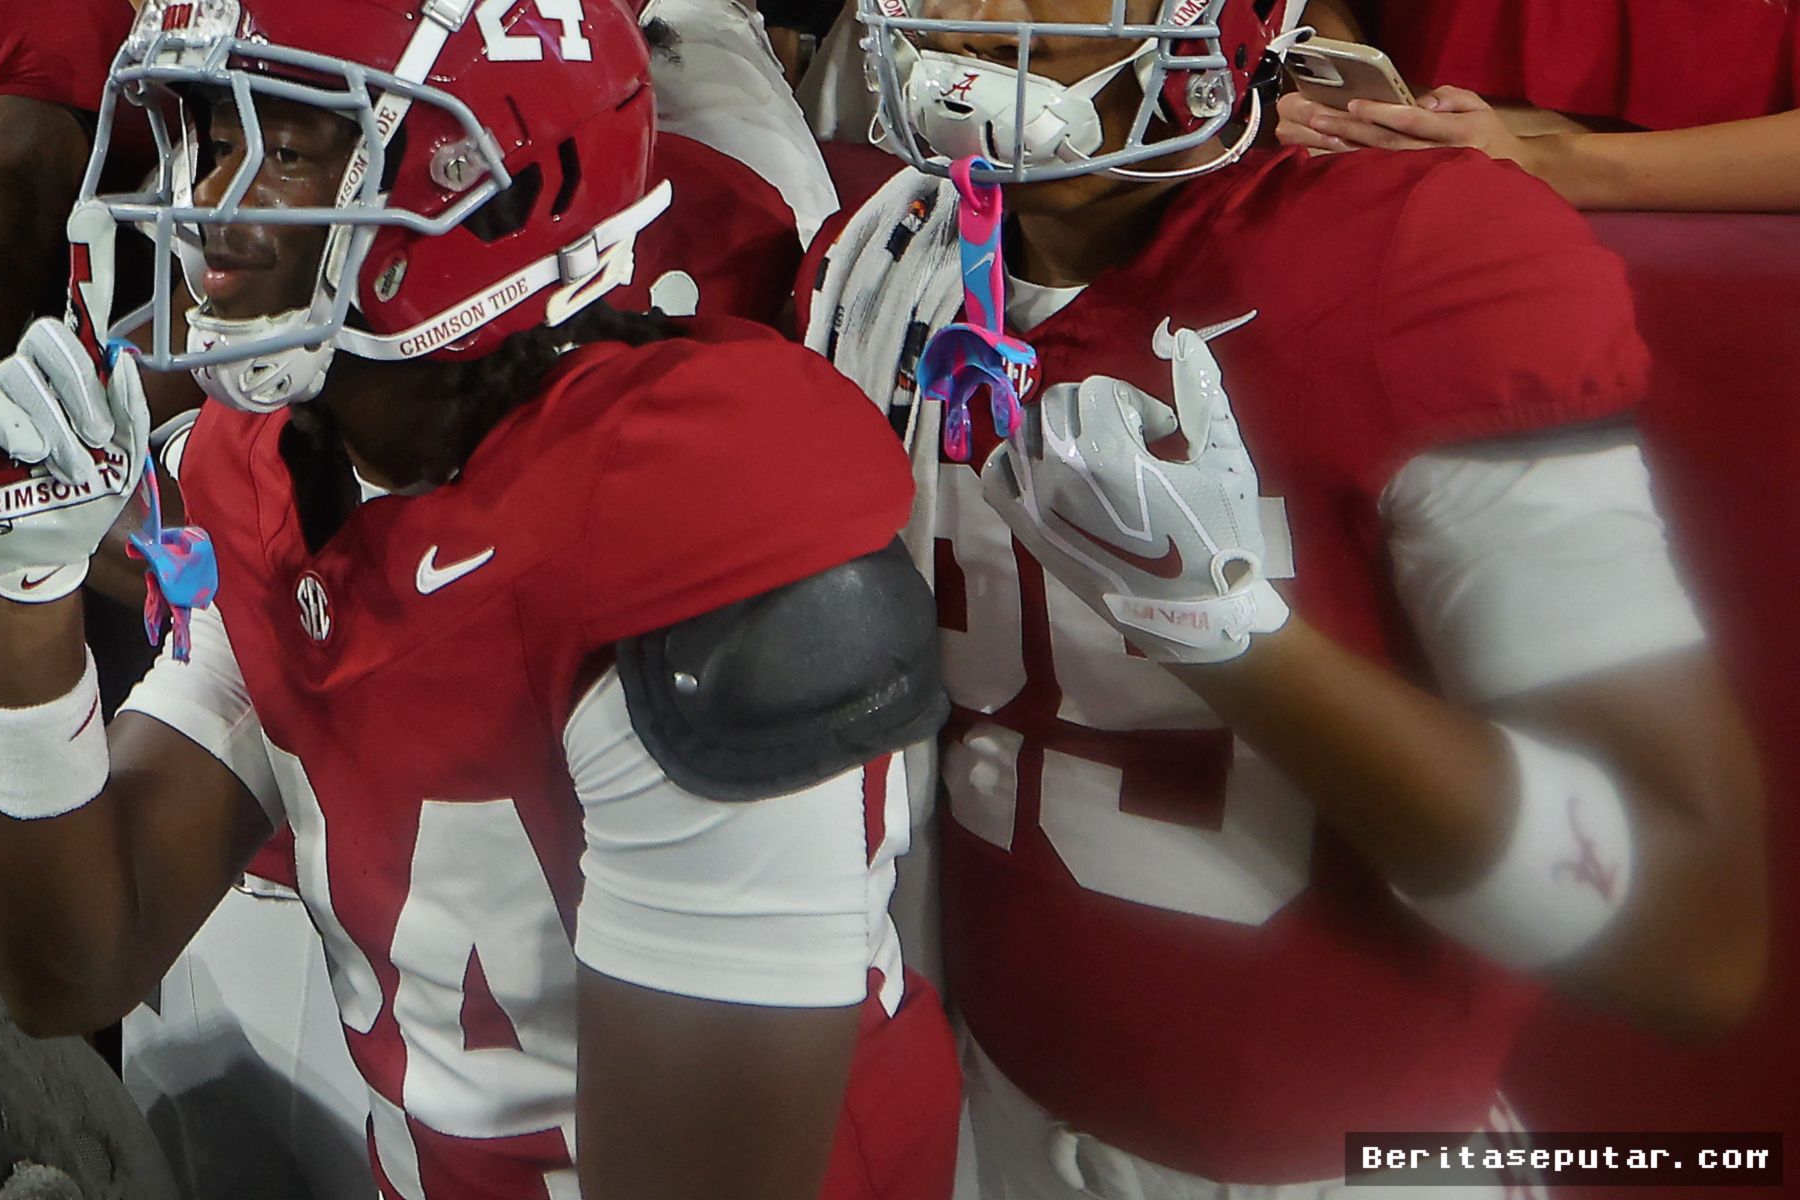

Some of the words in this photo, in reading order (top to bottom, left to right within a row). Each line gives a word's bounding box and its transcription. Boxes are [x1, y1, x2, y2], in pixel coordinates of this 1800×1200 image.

[940, 72, 980, 101] A
[399, 303, 487, 358] CRIMSON
[490, 277, 529, 312] TIDE
